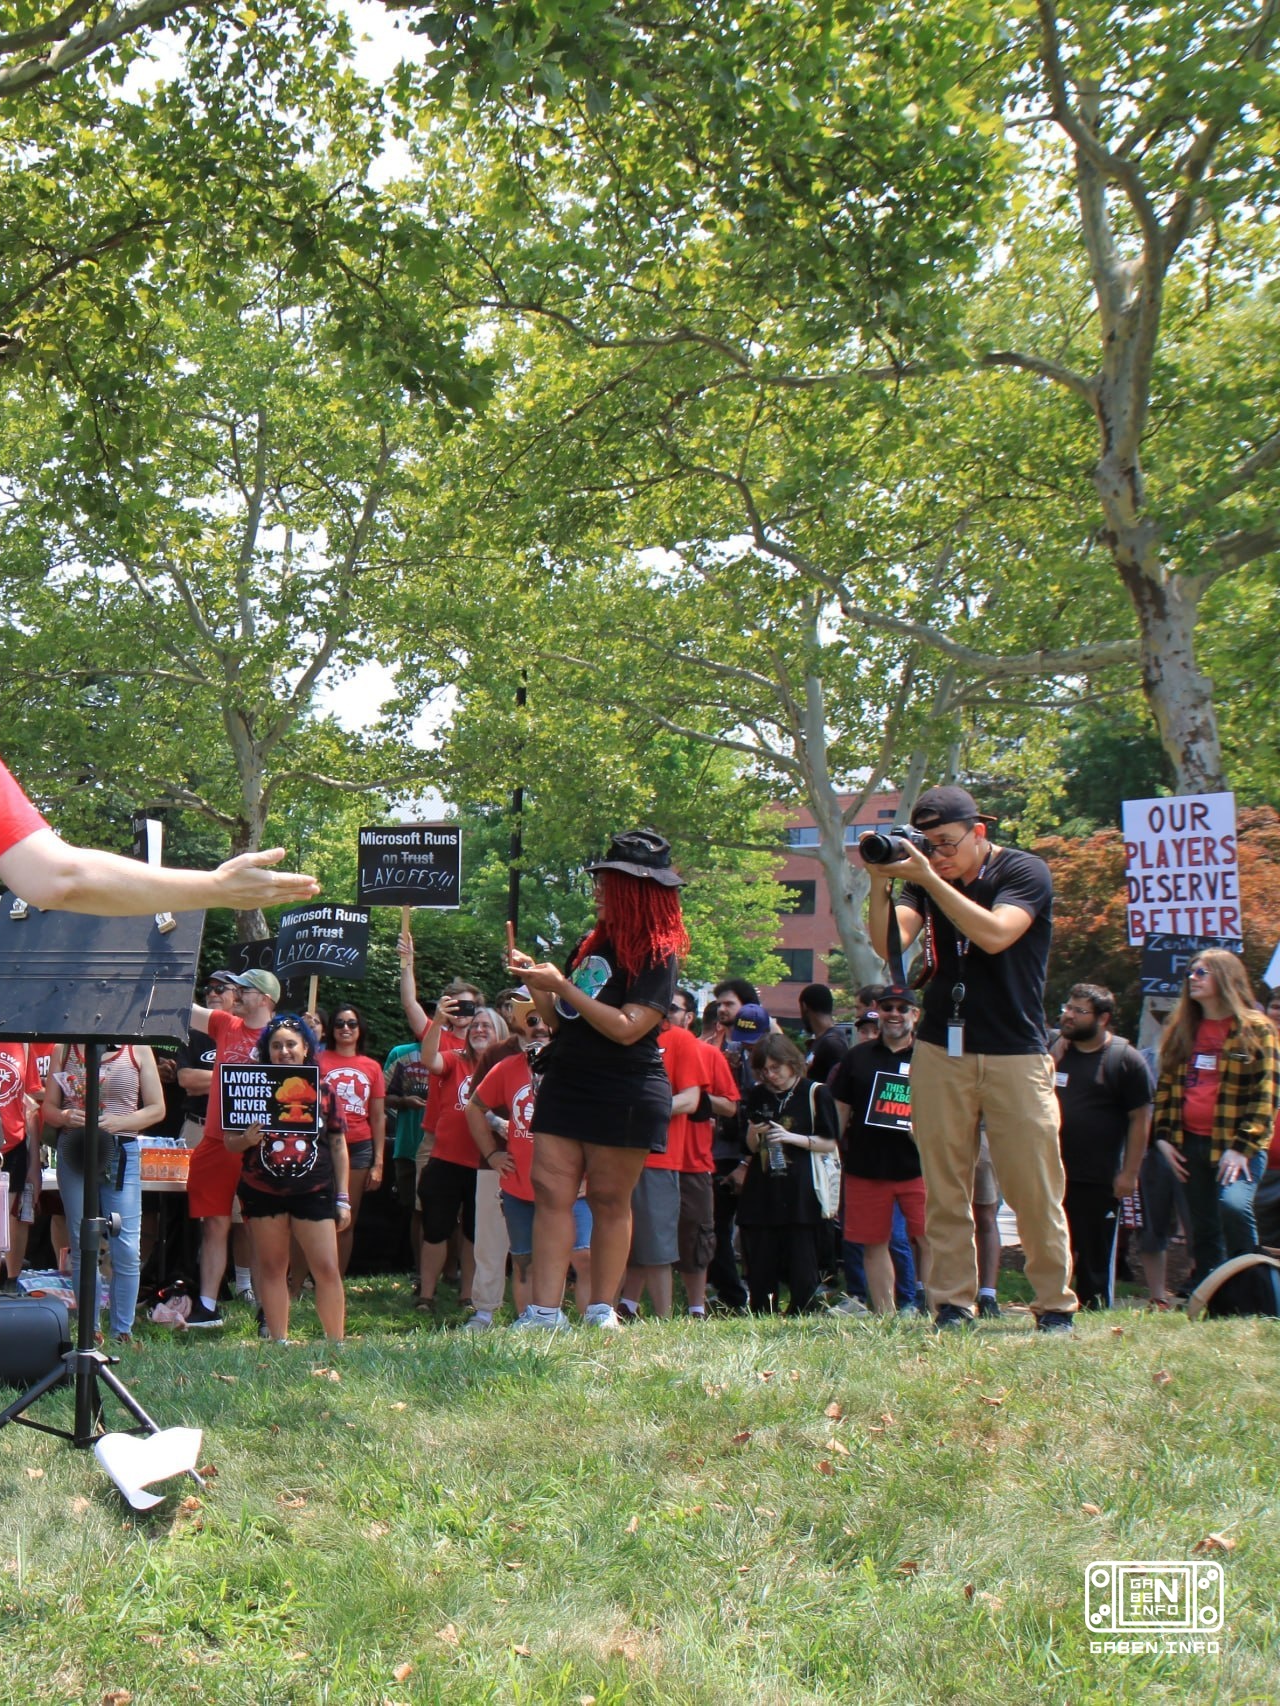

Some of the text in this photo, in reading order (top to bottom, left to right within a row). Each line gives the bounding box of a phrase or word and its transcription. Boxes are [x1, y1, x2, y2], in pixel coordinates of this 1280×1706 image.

[1148, 803, 1211, 833] OUR
[360, 832, 457, 845] Microsoft Runs
[382, 851, 434, 865] on Trust
[1126, 835, 1237, 870] PLAYERS
[361, 867, 455, 893] LAYOFFS!!!
[1128, 871, 1238, 904] DESERVE
[281, 907, 369, 928] Microsoft Runs
[1130, 906, 1241, 938] BETTER
[296, 925, 344, 940] on Trust
[276, 942, 360, 966] LAYOFFS!!!
[224, 1071, 277, 1085] LAYOFFS...
[228, 1085, 272, 1098] LAYOFFS
[880, 1090, 893, 1101] AN
[885, 1082, 905, 1095] THIS
[234, 1099, 267, 1112] NEVER
[229, 1112, 272, 1125] CHANGE
